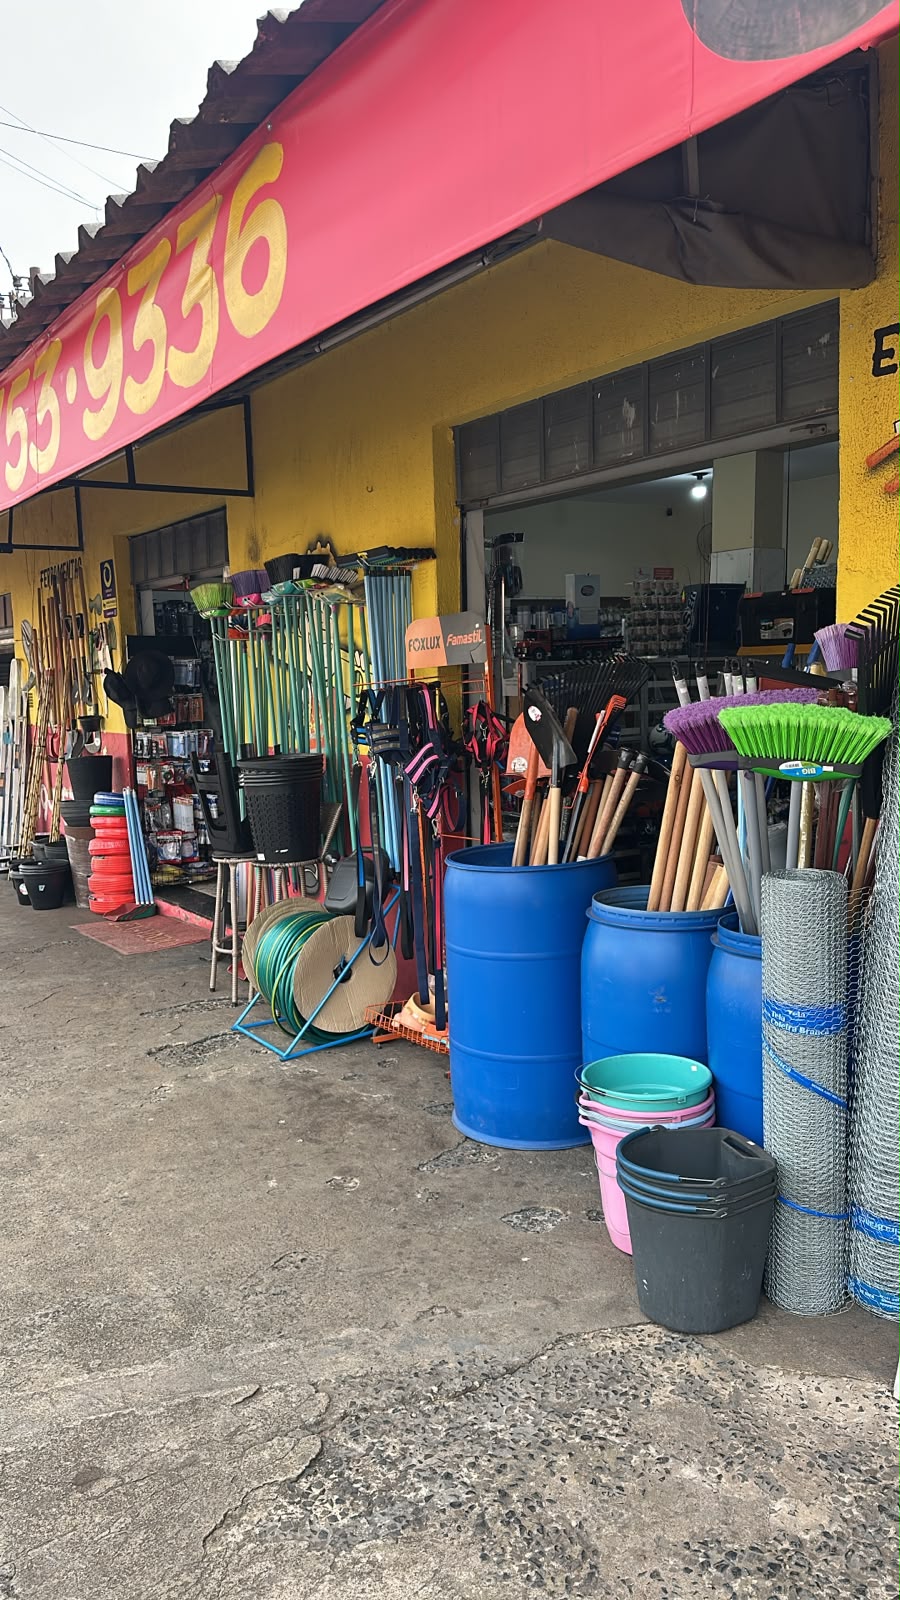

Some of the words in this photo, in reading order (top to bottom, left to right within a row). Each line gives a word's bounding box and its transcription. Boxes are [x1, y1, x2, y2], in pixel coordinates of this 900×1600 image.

[872, 322, 900, 378] E
[408, 635, 441, 652] FOXLUX
[446, 629, 483, 647] Famastil
